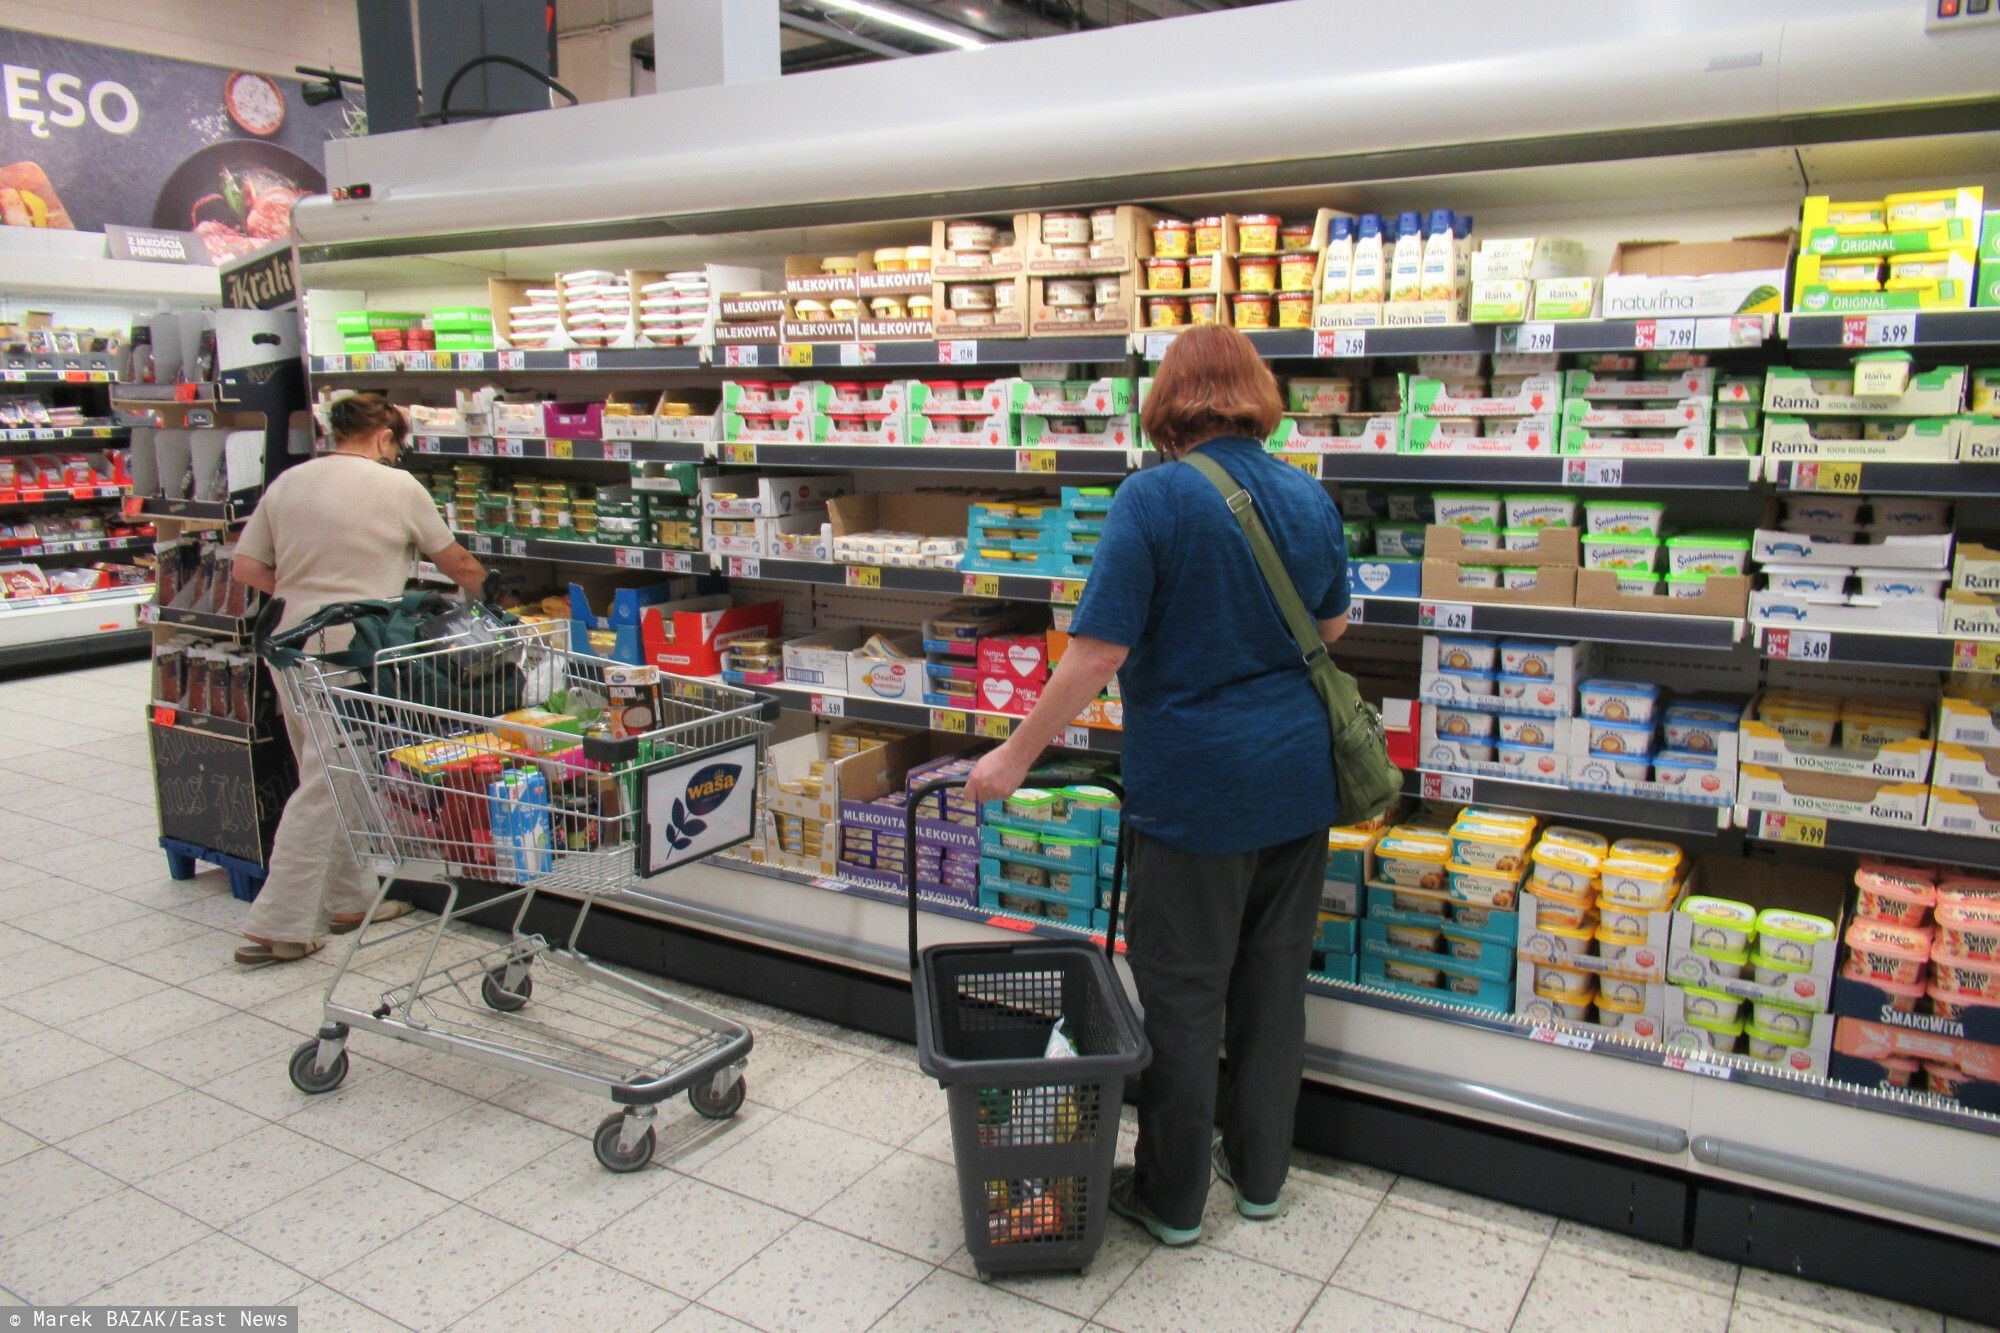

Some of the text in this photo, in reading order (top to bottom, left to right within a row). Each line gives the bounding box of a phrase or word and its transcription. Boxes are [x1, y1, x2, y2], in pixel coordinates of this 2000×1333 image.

[129, 245, 187, 260] PREMIUM
[1840, 238, 1896, 254] ORIGINAL
[786, 277, 853, 293] MLEKOVITA
[860, 272, 932, 288] MLEKOVITA
[1485, 290, 1512, 300] Rama
[1549, 289, 1578, 299] Rama
[723, 299, 785, 314] MLEKOVITA
[1832, 296, 1887, 309] ORIGINAL
[860, 320, 933, 335] MLEKOVITA
[1319, 316, 1353, 327] Rama
[1387, 314, 1422, 326] Rama
[1844, 320, 1865, 332] VAT
[716, 325, 777, 339] MLEKOVITA
[787, 321, 853, 336] MLEKOVITA
[1636, 325, 1655, 335] VAT
[1881, 324, 1908, 342] 5.99
[1531, 334, 1551, 349] 7.99
[1636, 335, 1654, 347] 0%
[1669, 330, 1692, 345] 7.99
[1345, 339, 1364, 353] 7.59
[1863, 371, 1892, 381] Rama
[1413, 403, 1457, 413] ProActiv
[1771, 394, 1821, 410] Rama
[1026, 435, 1059, 446] ProActiv
[1268, 439, 1308, 449] ProActiv
[1409, 440, 1453, 450] ProActiv
[1770, 439, 1819, 454] Rama
[1600, 469, 1621, 484] 10.79
[1834, 473, 1858, 489] 9.99
[1441, 504, 1490, 521] Śniadaniowa
[1513, 504, 1573, 522] Śniadaniowa
[1594, 511, 1649, 530] Śniadaniowa
[1592, 546, 1645, 563] Śniadaniowa
[1677, 552, 1734, 568] Śniadaniowa
[1348, 606, 1363, 621] .99
[1446, 613, 1466, 628] 6.29
[1768, 633, 1789, 644] VAT
[1802, 640, 1828, 656] 5.49
[1778, 725, 1809, 737] Rama
[1073, 733, 1088, 746] 8.99
[1871, 763, 1916, 779] Rama
[687, 773, 736, 800] wasa
[1451, 786, 1471, 800] 6.29
[843, 809, 906, 828] MLEKOVITA
[1869, 804, 1913, 820] Rama
[915, 826, 976, 847] LEKOVITA
[1799, 825, 1824, 841] 9.99
[1463, 847, 1495, 861] Benecol
[1388, 864, 1420, 875] Benecol
[1459, 881, 1492, 893] Benecol
[1880, 1004, 1965, 1038] SMAKOWITA
